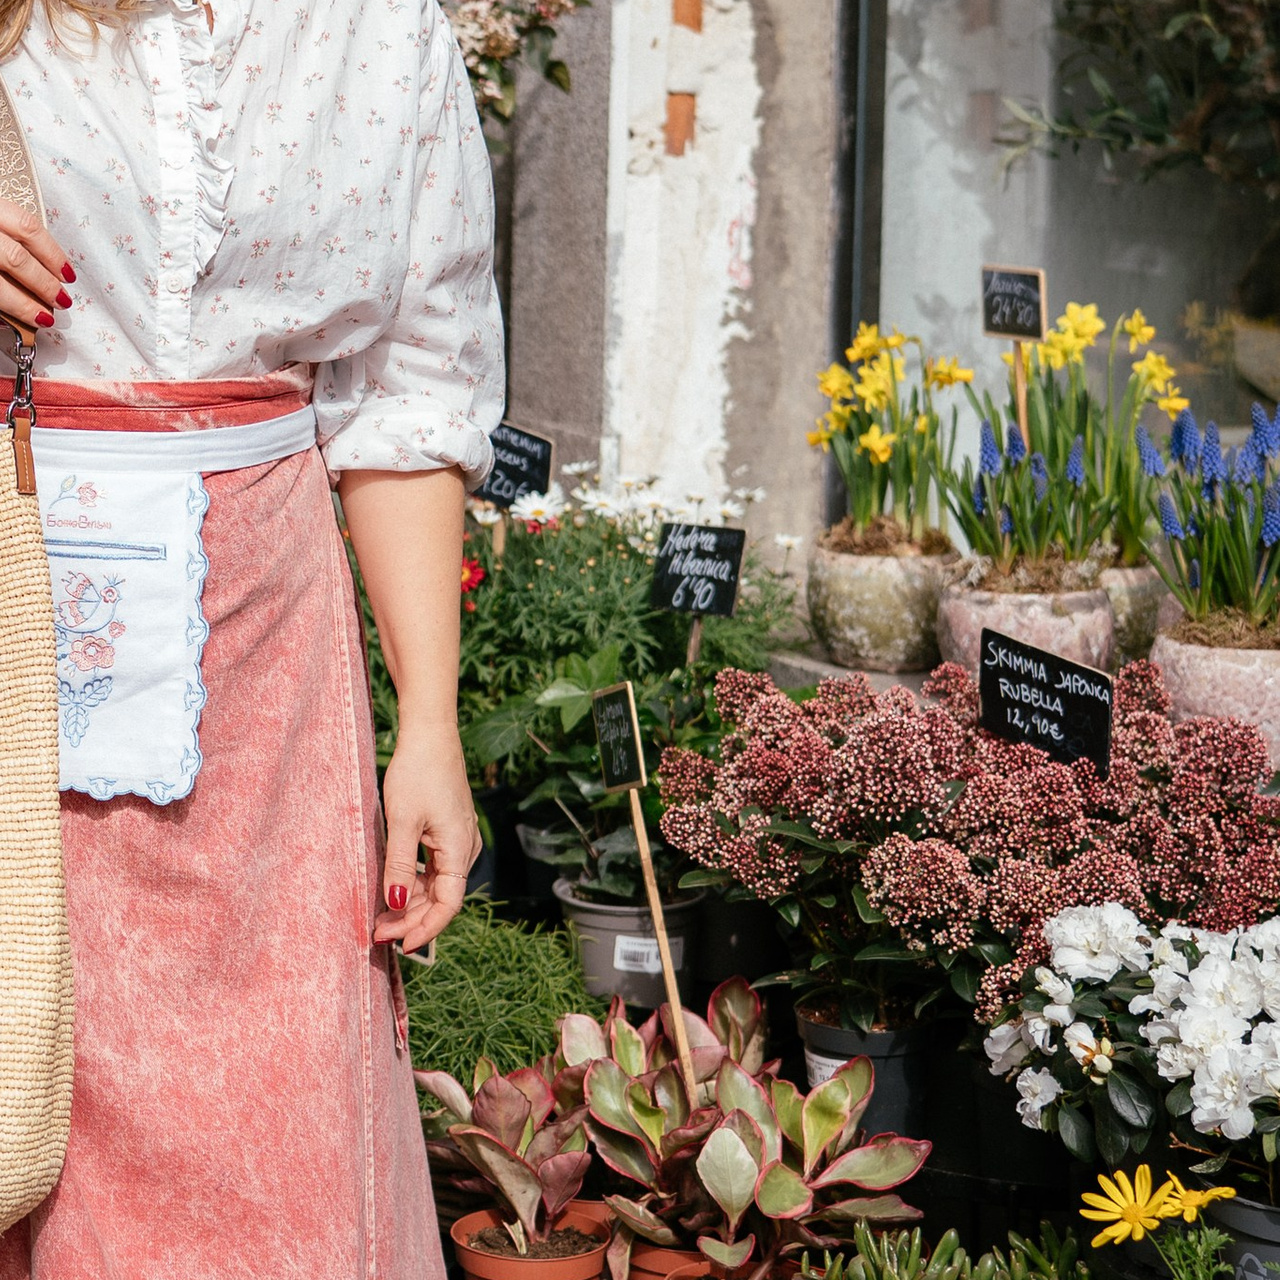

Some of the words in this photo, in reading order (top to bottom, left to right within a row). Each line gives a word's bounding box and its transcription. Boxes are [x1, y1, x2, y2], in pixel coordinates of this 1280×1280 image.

[660, 523, 717, 558] Hedera
[672, 576, 716, 610] 6'90
[984, 641, 1047, 683] SKIMMIA
[999, 678, 1063, 716] RUBELLA
[1007, 707, 1064, 740] 12,90€
